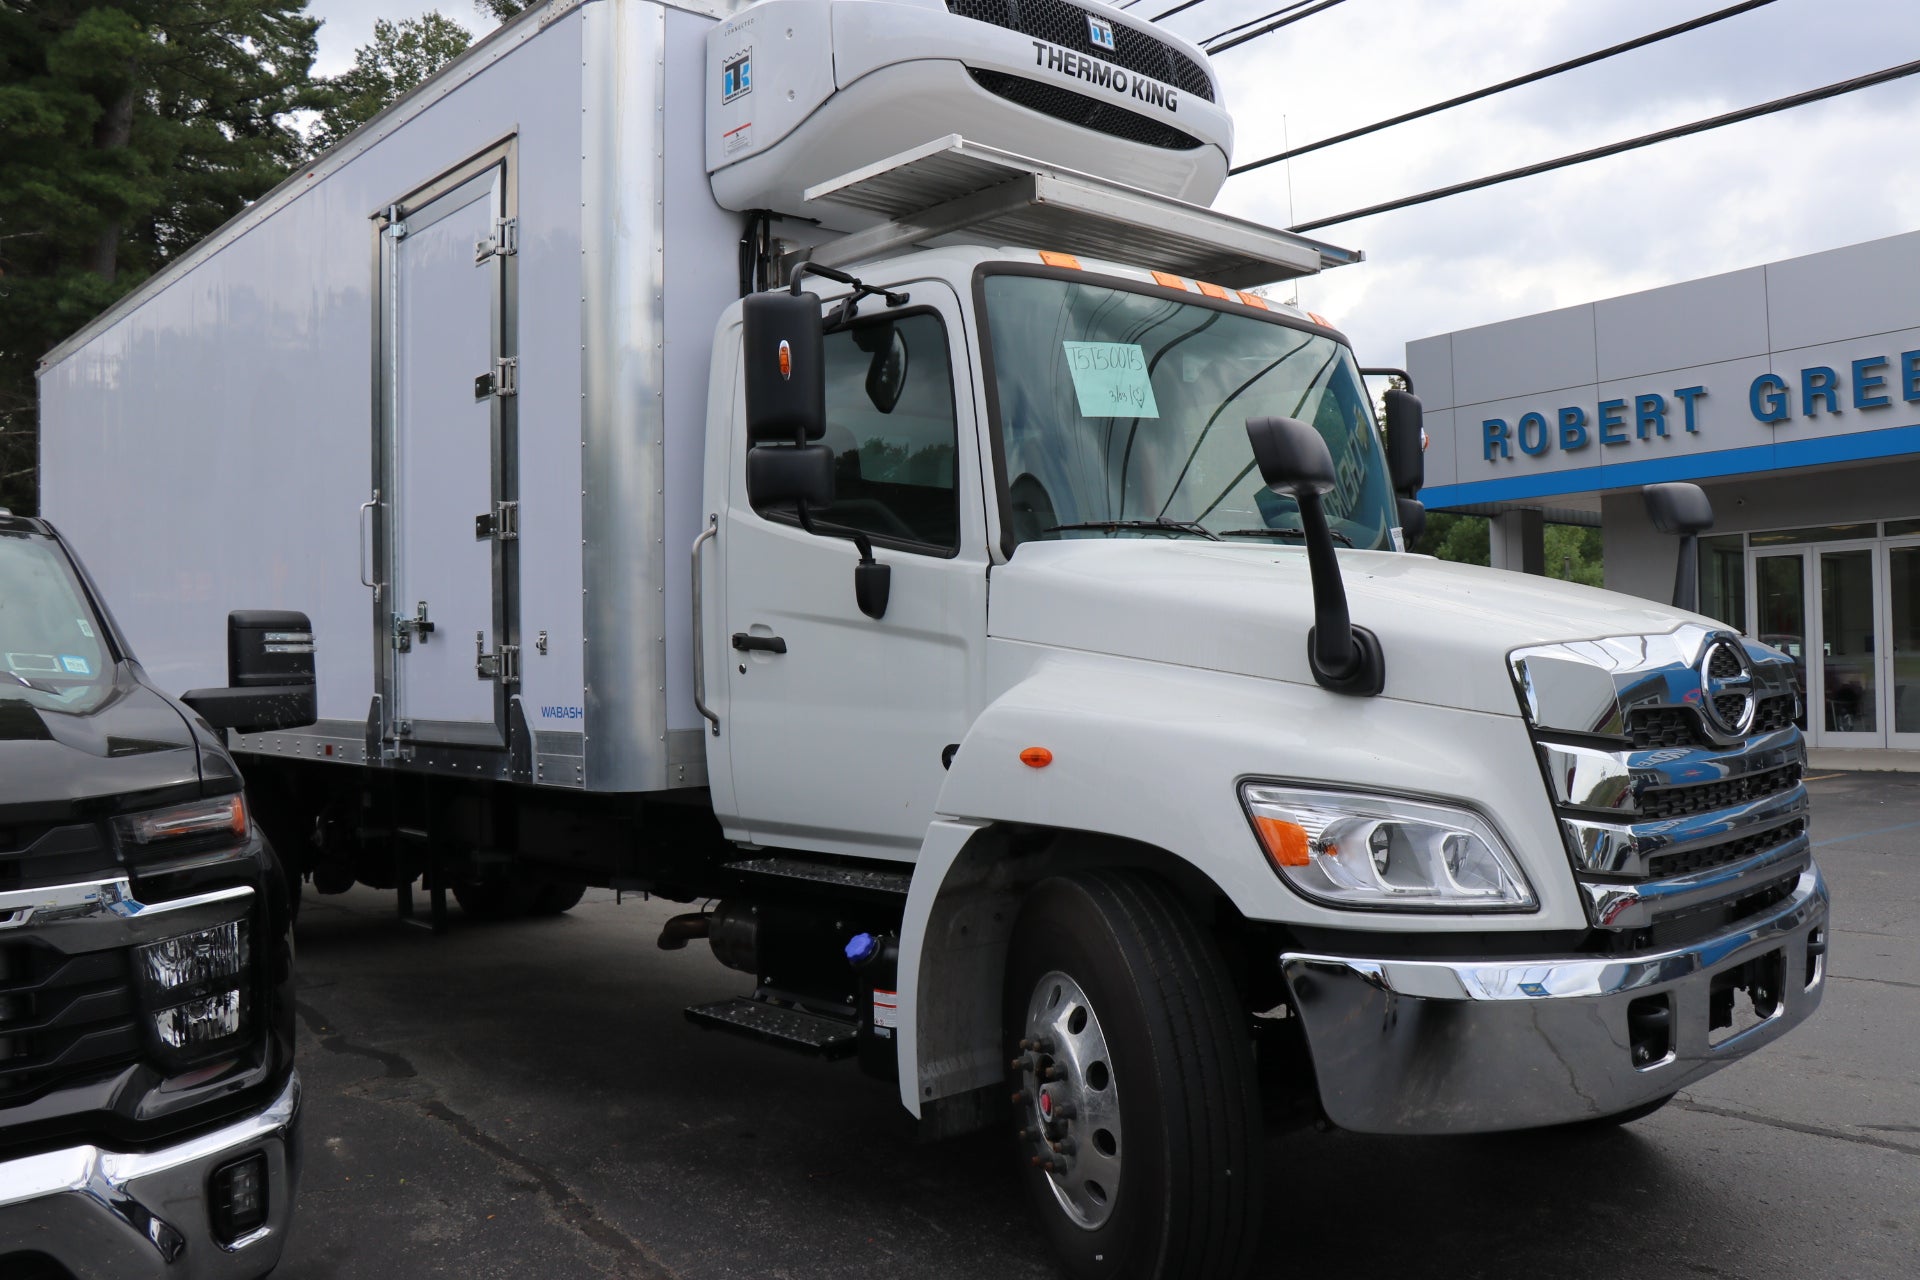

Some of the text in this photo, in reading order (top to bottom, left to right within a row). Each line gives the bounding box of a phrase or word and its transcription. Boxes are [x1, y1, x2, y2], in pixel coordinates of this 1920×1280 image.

[1032, 41, 1178, 113] THERMO KING
[1482, 385, 1707, 462] ROBERT
[541, 705, 583, 719] WABASH
